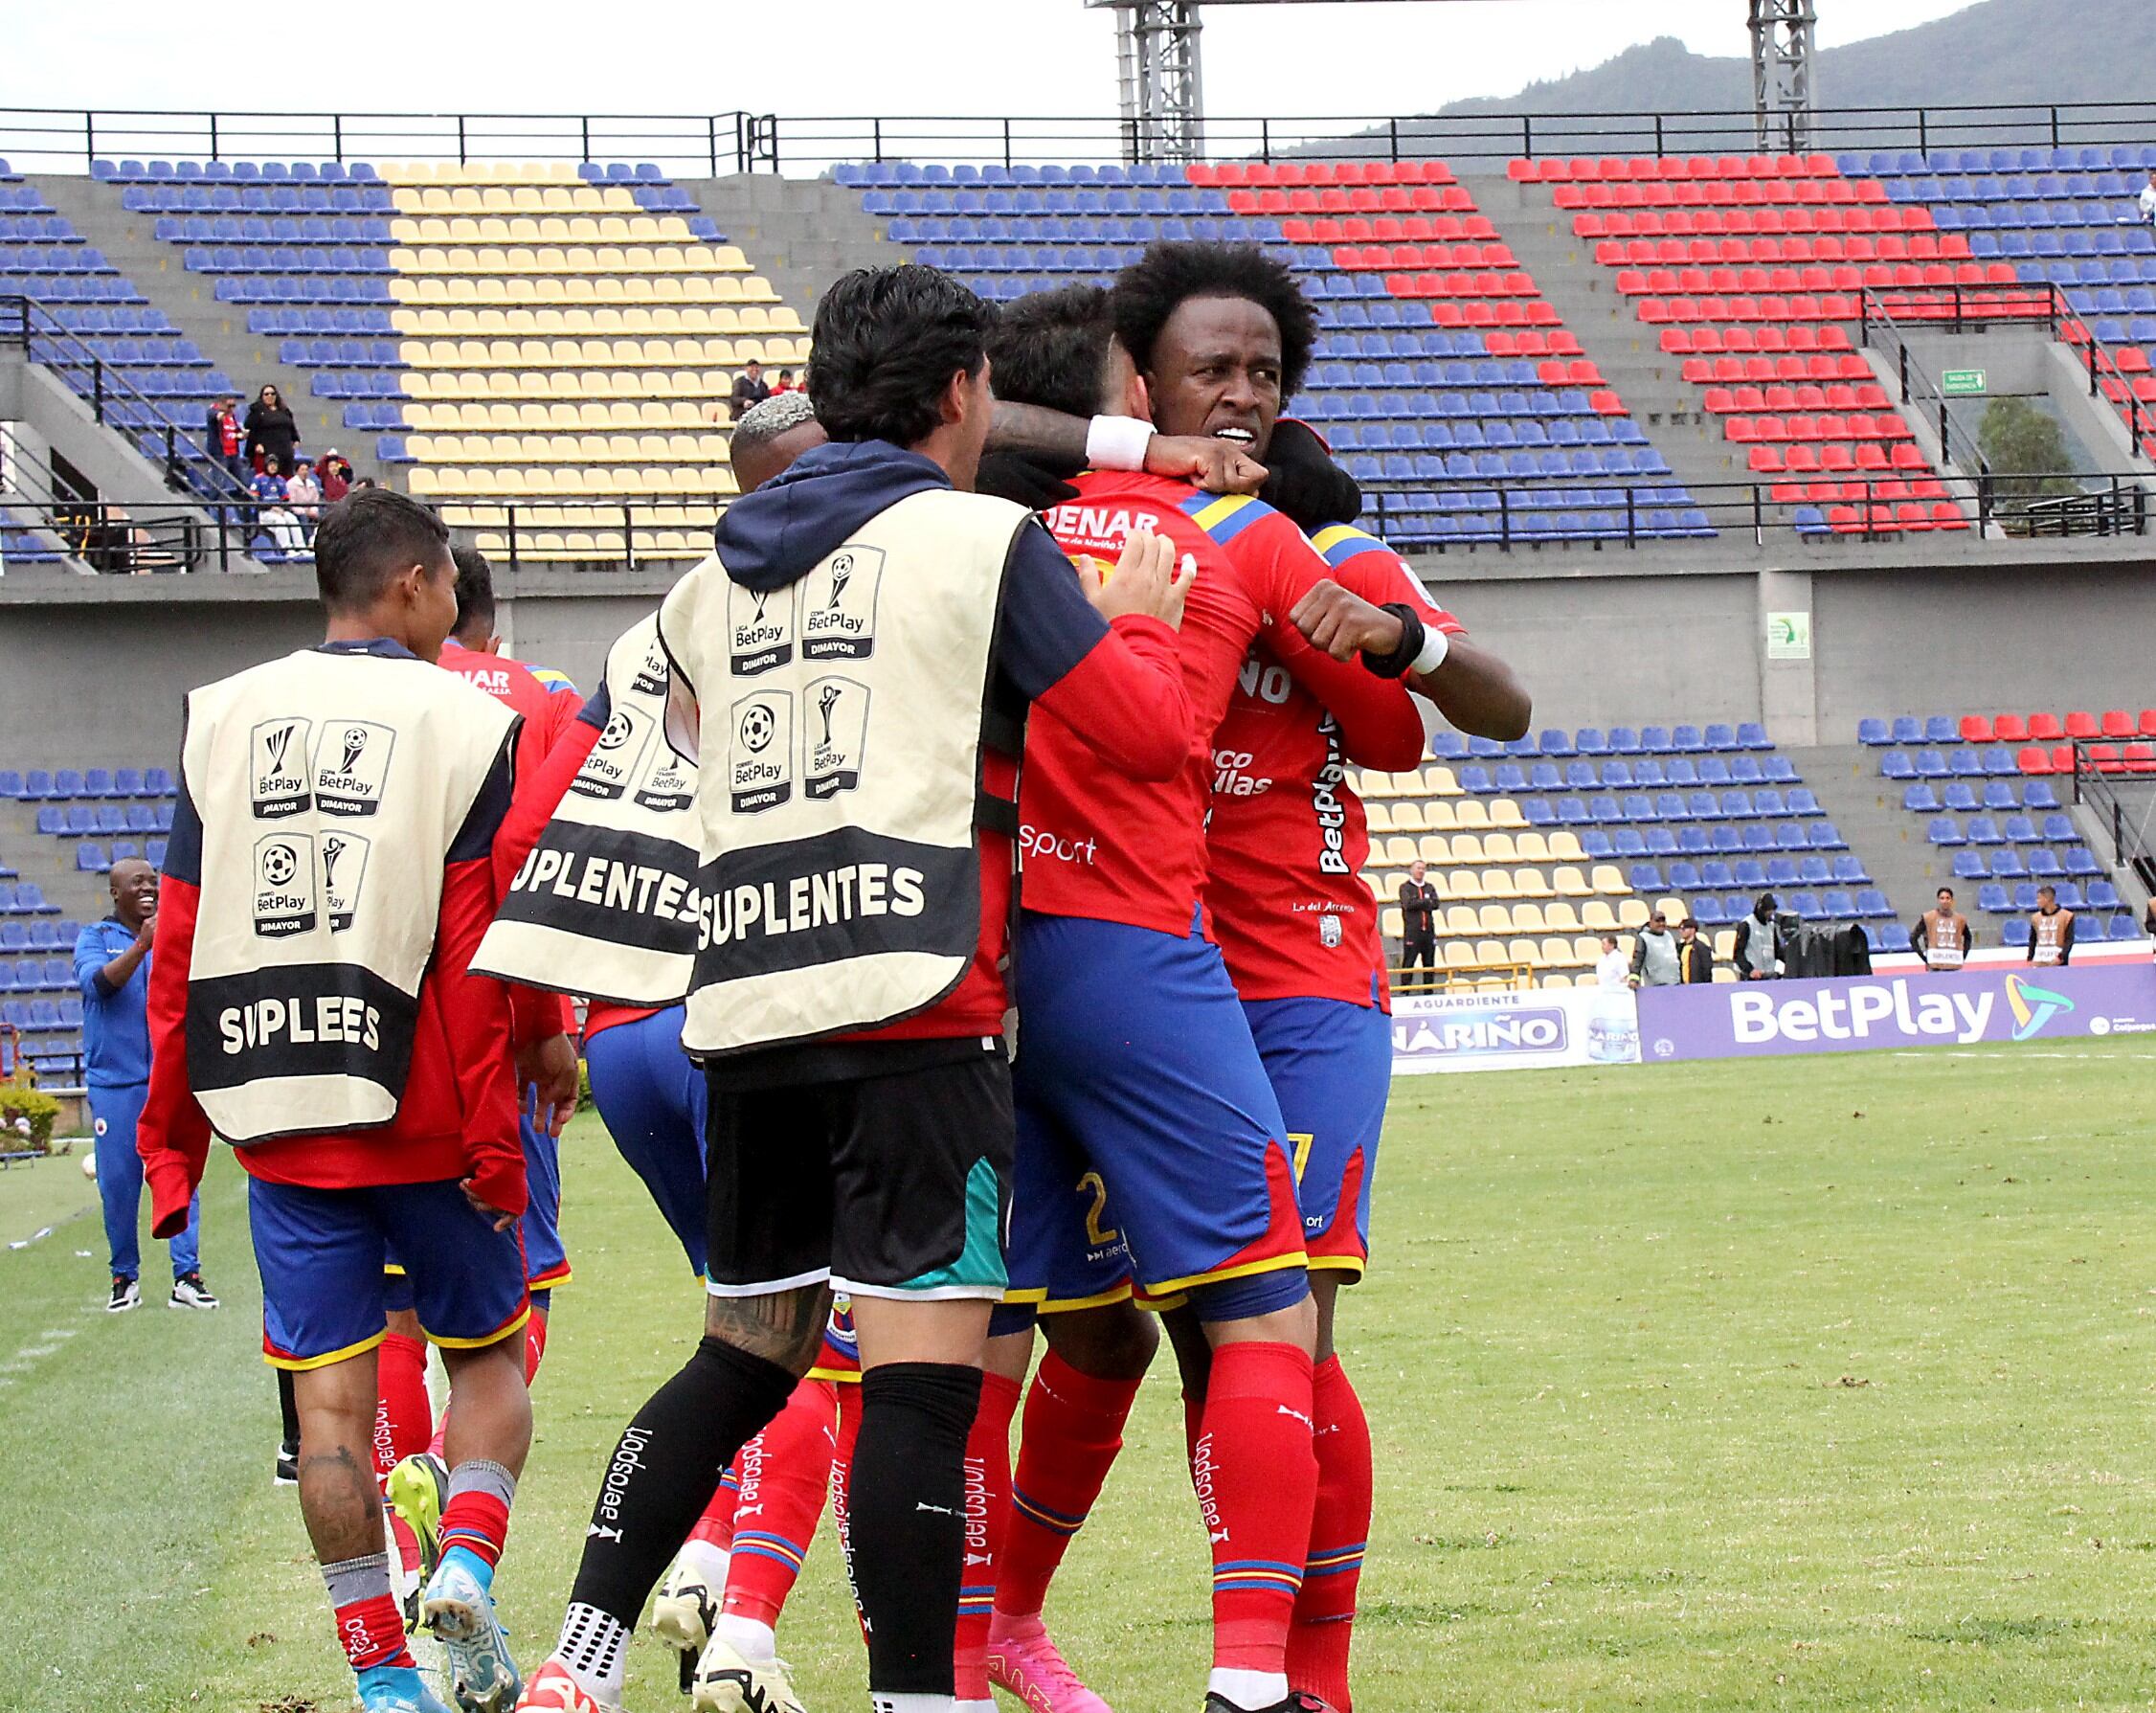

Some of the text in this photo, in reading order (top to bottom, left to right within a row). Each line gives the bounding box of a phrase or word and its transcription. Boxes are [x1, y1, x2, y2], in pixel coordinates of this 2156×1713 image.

[808, 613, 864, 633] BetPlay
[736, 625, 783, 647] BetPlay
[811, 642, 856, 655] DIMAYOR
[742, 654, 777, 671] DIMAYOR
[735, 762, 781, 784] BetPlay
[319, 775, 373, 796] BetPlay
[321, 800, 363, 813] DIMAYOR
[740, 793, 776, 808] DIMAYOR
[258, 894, 305, 912] BetPlay
[698, 864, 925, 951] SUPLENTES
[1413, 995, 1520, 1009] AGUARDIENTE
[1730, 980, 1994, 1044] BetPlay
[1076, 1172, 1118, 1245] 2
[600, 1427, 653, 1521] aerosport
